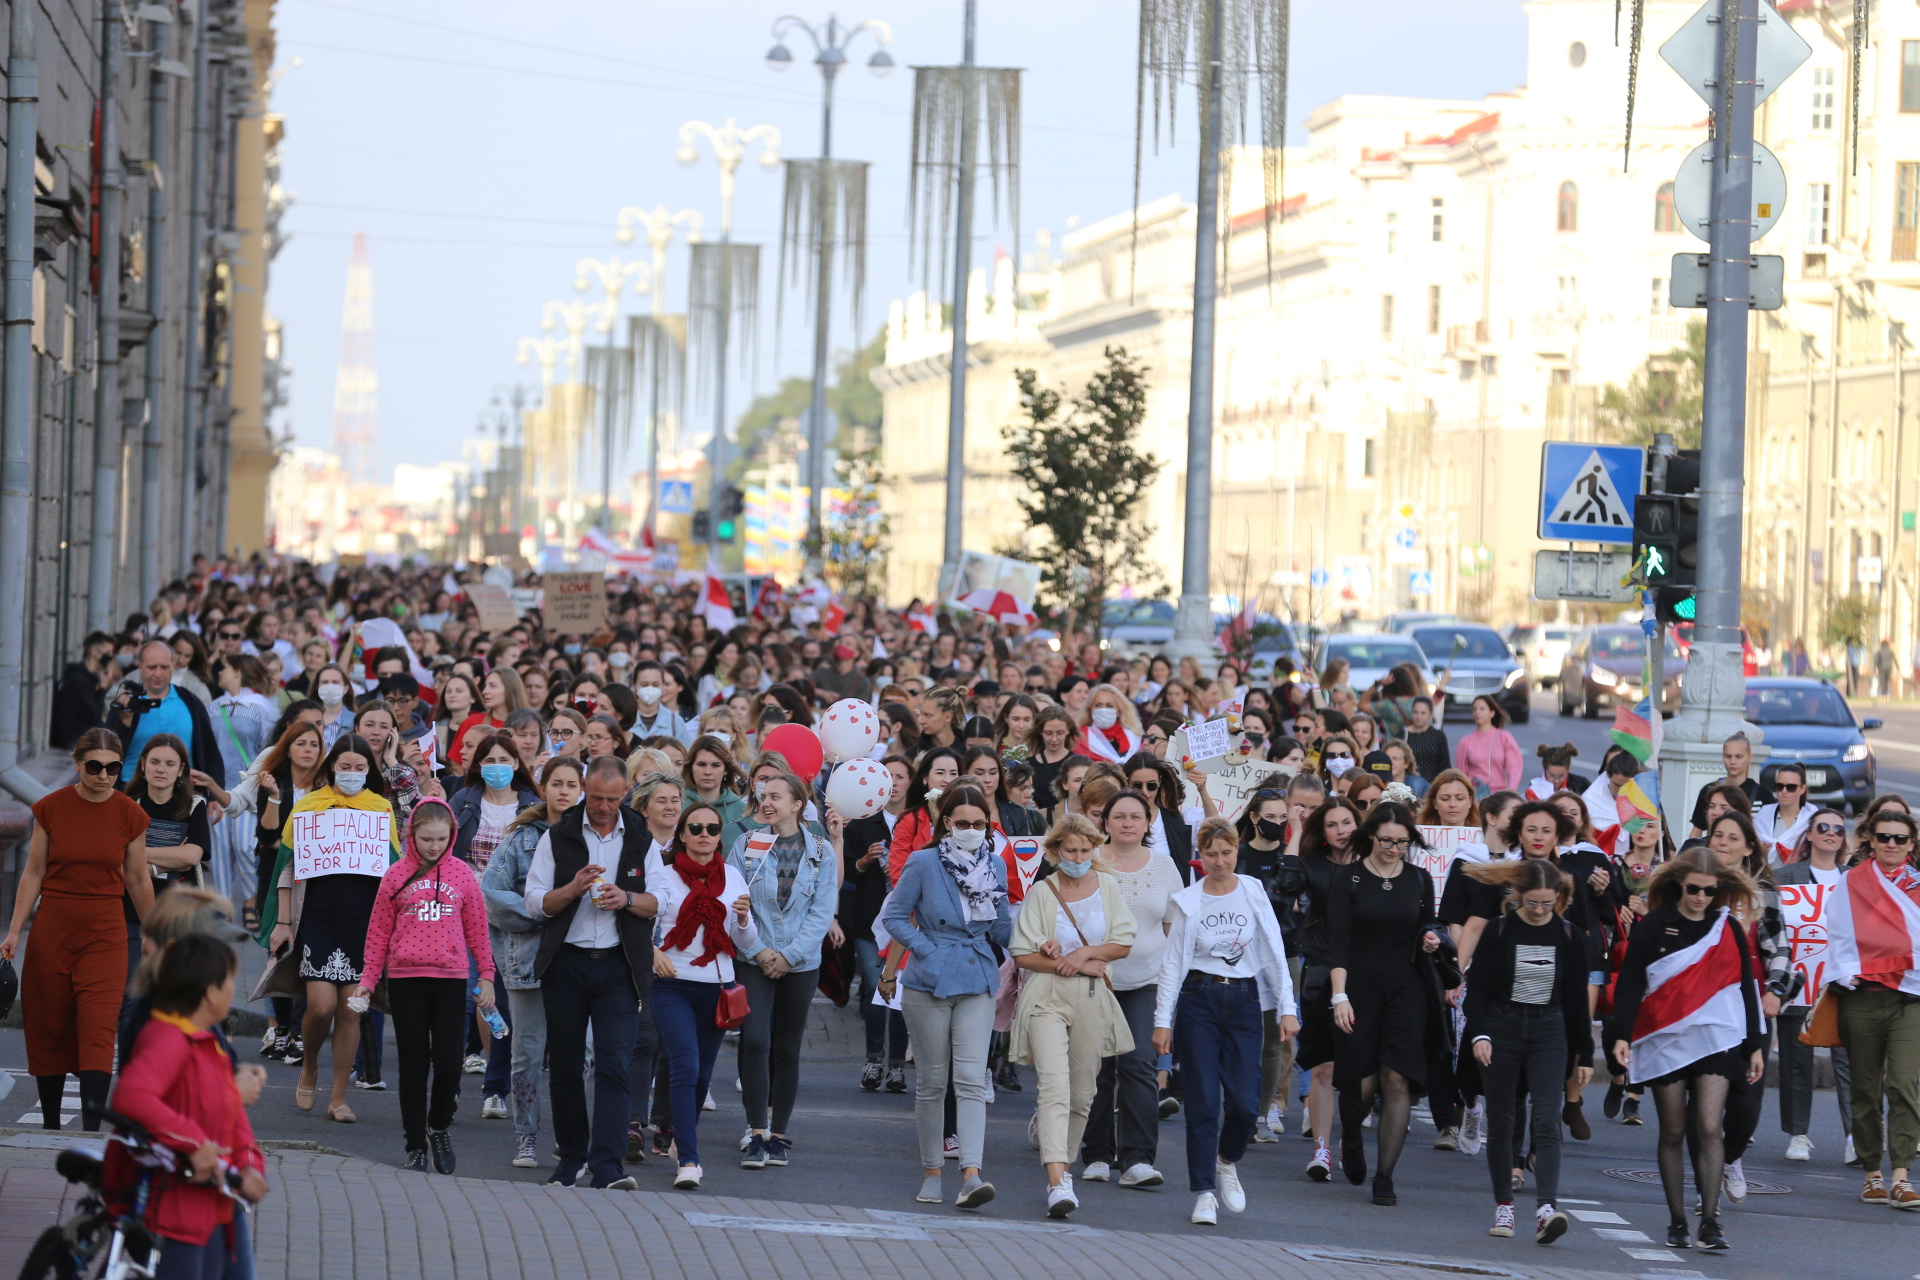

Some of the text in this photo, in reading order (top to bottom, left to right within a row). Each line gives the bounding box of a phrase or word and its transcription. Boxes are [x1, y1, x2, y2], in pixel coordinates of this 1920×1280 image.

[560, 582, 591, 594] LOVE
[293, 812, 389, 842] THE HAGUE
[314, 856, 341, 872] FOR
[418, 899, 440, 922] 28
[1200, 911, 1248, 930] TOKYO
[1215, 928, 1237, 936] JAPAN
